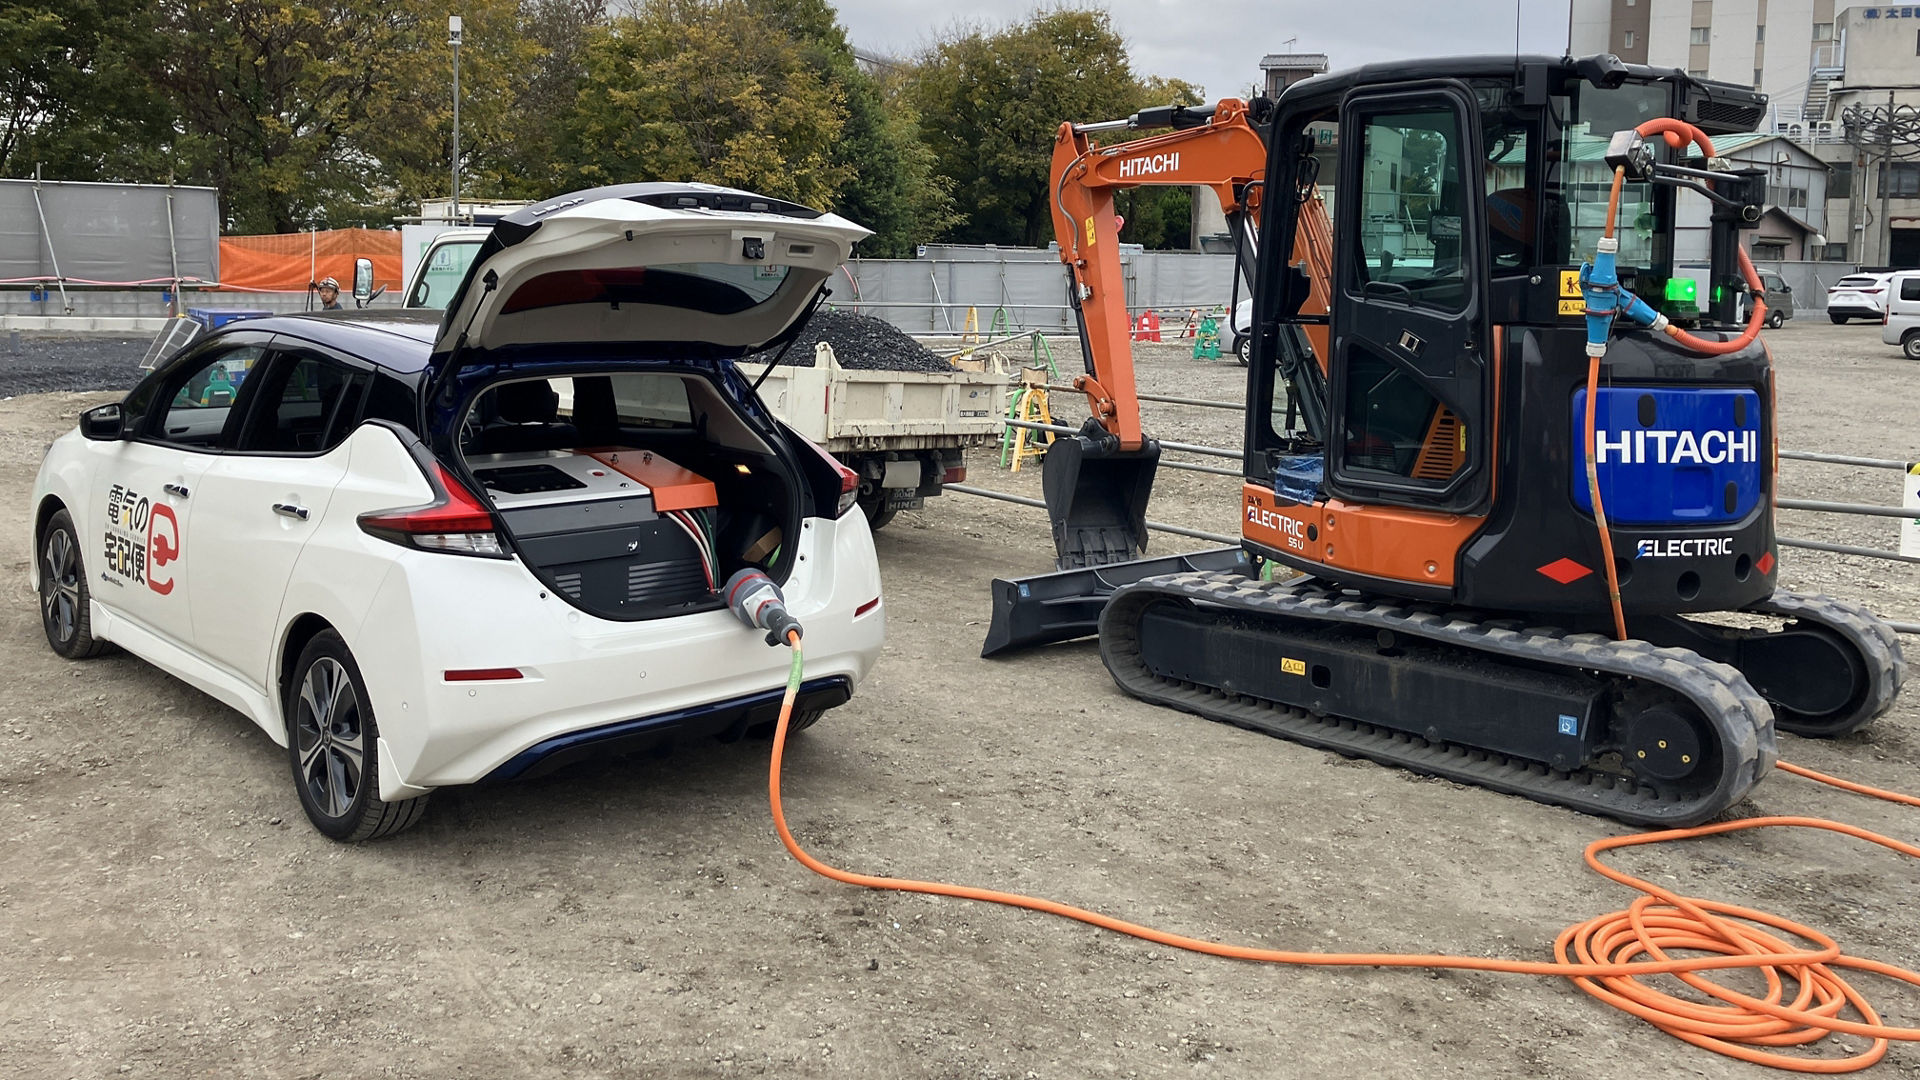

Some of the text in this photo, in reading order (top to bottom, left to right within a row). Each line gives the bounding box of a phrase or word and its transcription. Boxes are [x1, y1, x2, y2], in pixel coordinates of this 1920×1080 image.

[1119, 152, 1180, 178] HITACHI
[1596, 430, 1757, 464] HITACHI
[108, 484, 149, 533] 電気の
[1247, 505, 1304, 539] ELECTRIC
[104, 531, 146, 586] 宅配便
[1636, 538, 1733, 559] ELECTRIC
